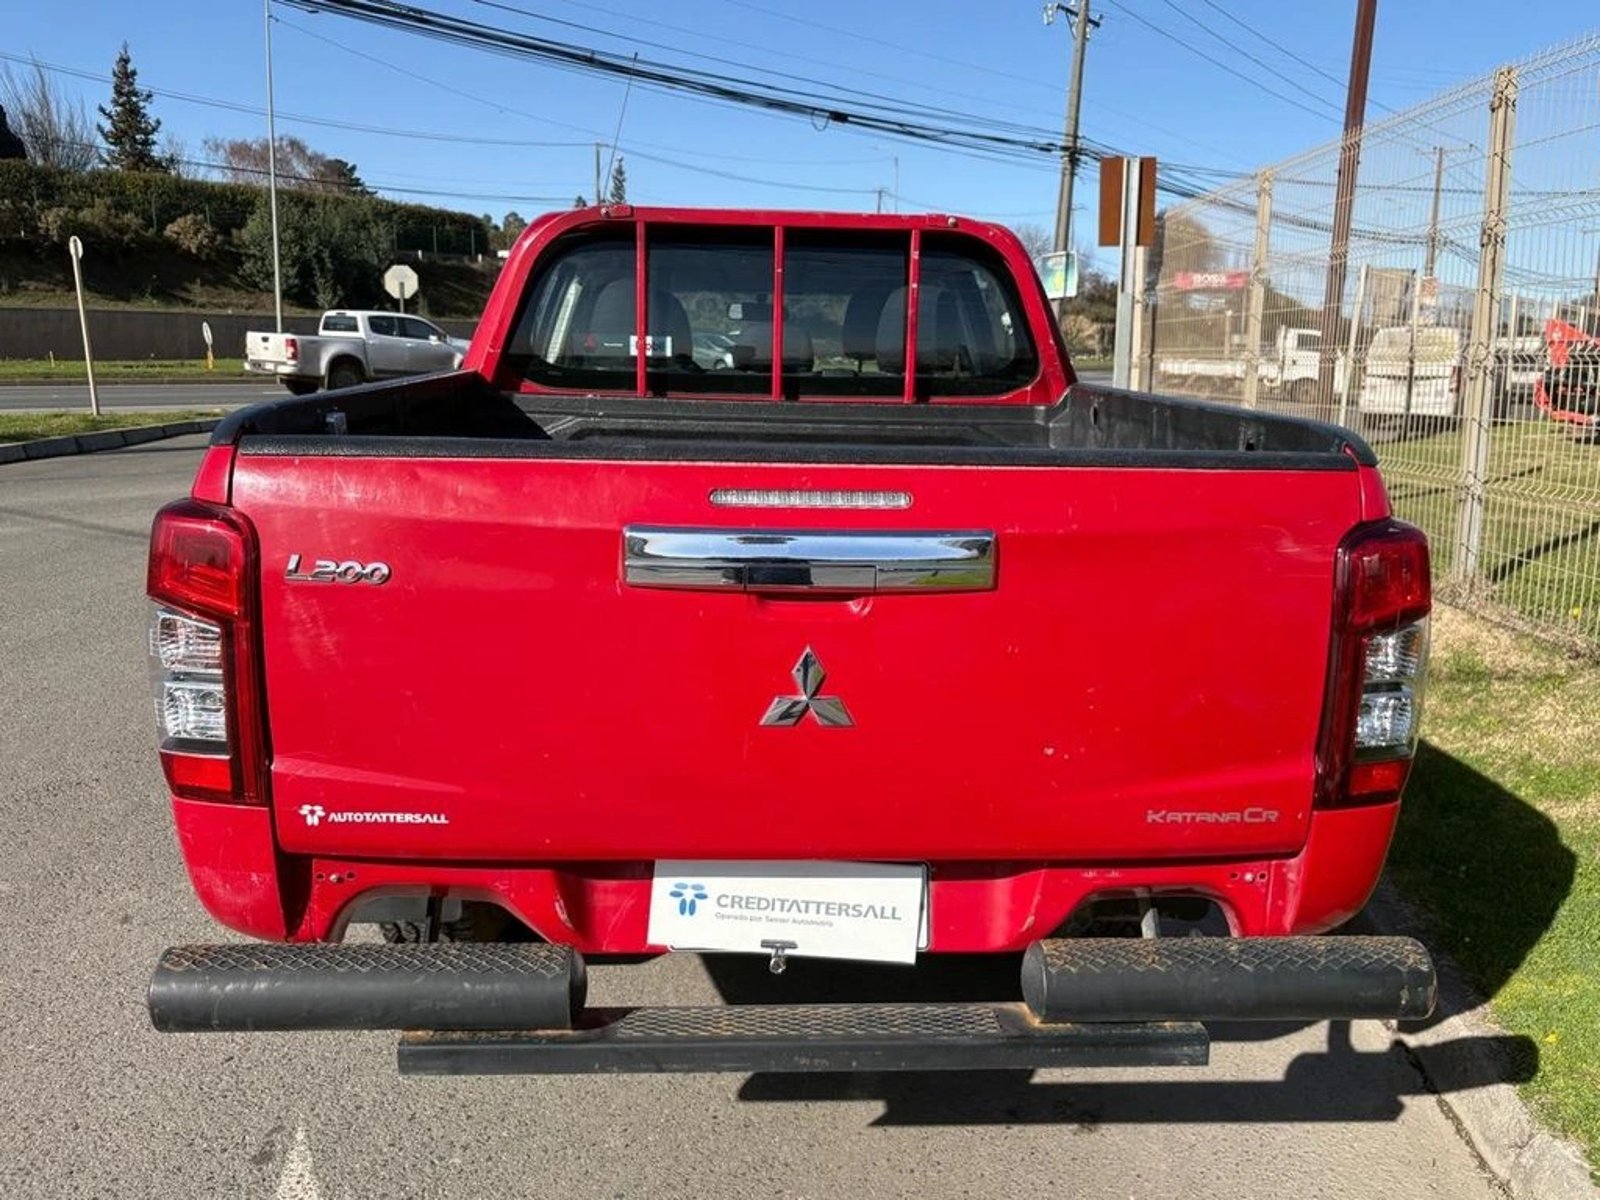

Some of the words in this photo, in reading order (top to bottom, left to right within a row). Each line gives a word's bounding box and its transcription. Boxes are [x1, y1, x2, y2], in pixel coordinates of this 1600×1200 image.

[285, 553, 391, 585] L200
[328, 811, 450, 825] AUTOTATTERSALL
[717, 893, 902, 921] CREDITATTERSALL
